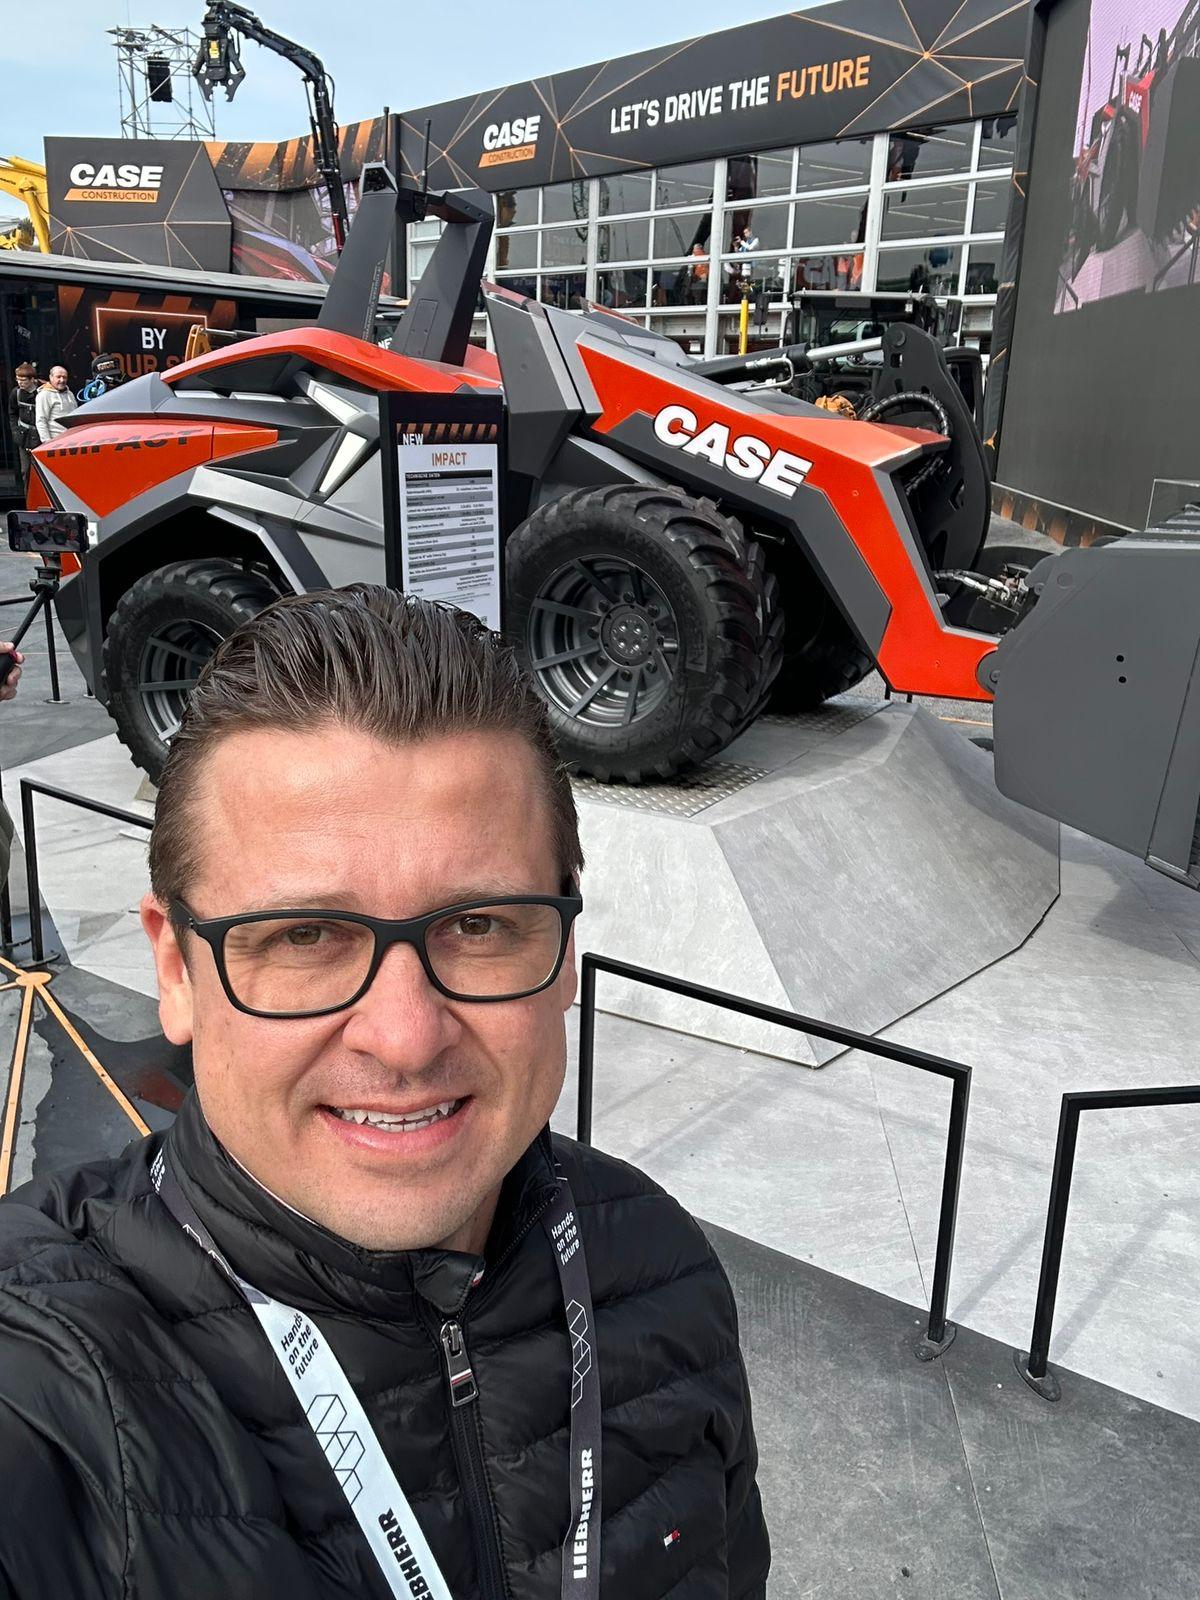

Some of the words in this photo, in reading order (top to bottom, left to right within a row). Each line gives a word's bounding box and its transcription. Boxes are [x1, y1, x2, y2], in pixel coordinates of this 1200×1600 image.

[610, 99, 660, 133] LET'S
[664, 85, 723, 123] DRIVE
[728, 75, 770, 110] THE
[776, 55, 871, 101] FUTURE
[483, 114, 541, 151] CASE
[69, 163, 164, 188] CASE
[81, 190, 155, 201] CONSTRUCTION
[141, 327, 167, 350] BY
[91, 351, 158, 378] OUR
[47, 428, 205, 458] IMPACT
[402, 433, 424, 447] NEW
[652, 403, 813, 499] CASE
[432, 452, 467, 467] IMPACT
[551, 1211, 574, 1239] Hands
[556, 1238, 566, 1252] on
[564, 1225, 577, 1242] the
[560, 1238, 580, 1266] future
[280, 1312, 303, 1352] Hands
[288, 1346, 300, 1365] on
[298, 1324, 312, 1348] the
[294, 1338, 319, 1380] future
[573, 1447, 594, 1580] LIEBHERR
